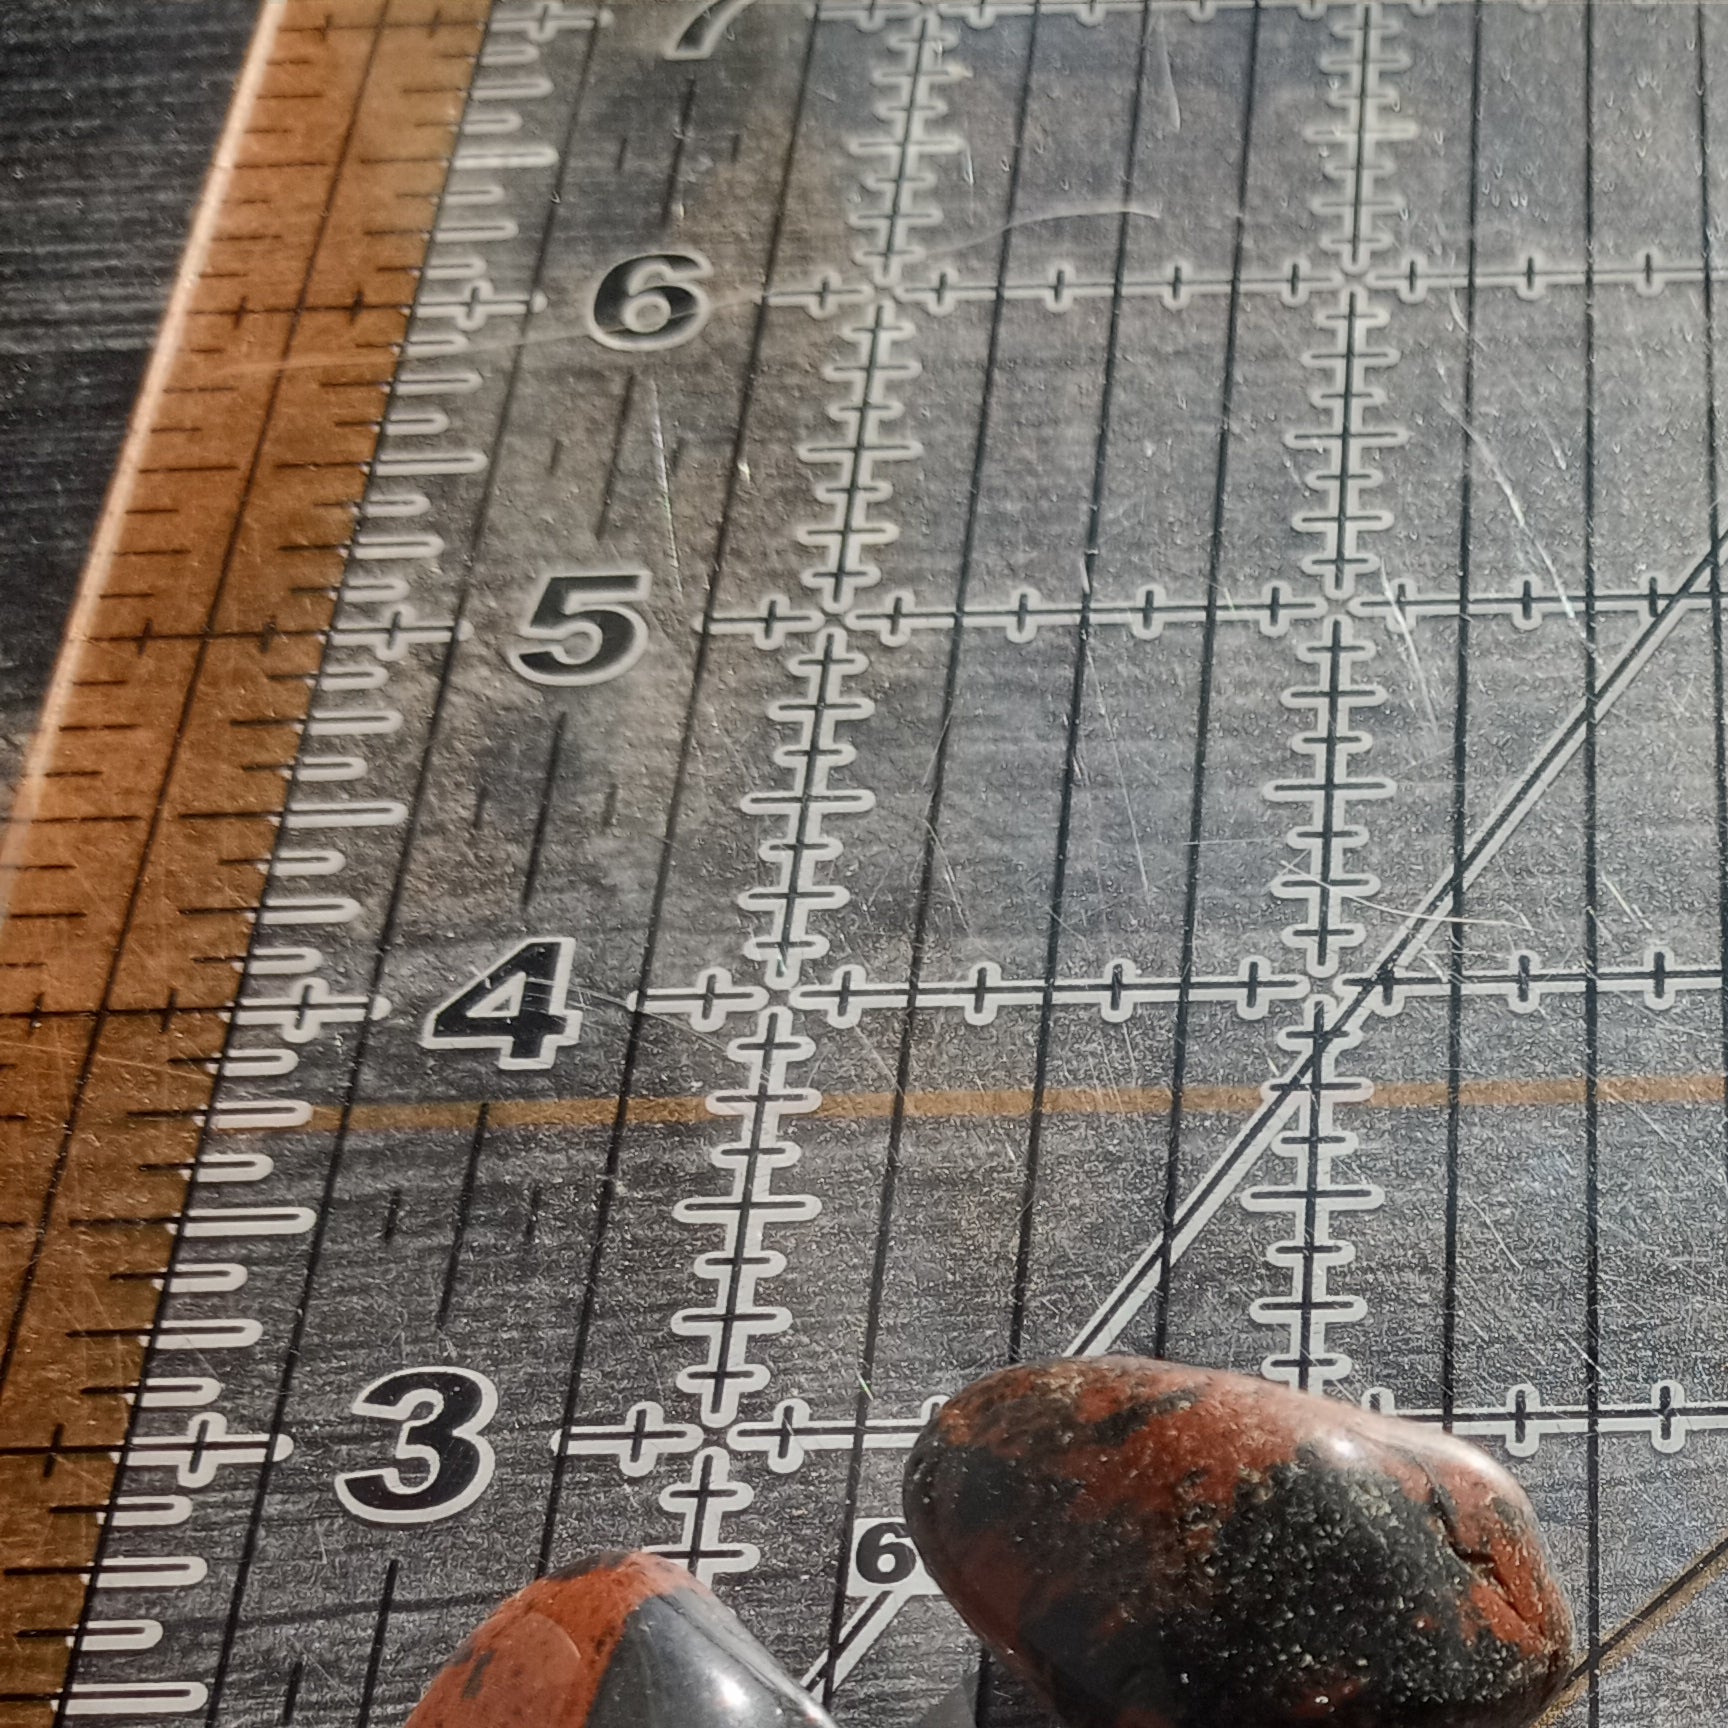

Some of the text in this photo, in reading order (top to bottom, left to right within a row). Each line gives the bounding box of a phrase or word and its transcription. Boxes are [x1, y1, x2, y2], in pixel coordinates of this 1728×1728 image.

[590, 252, 713, 350] 6
[510, 571, 651, 686] 5
[422, 937, 584, 1070] 4
[334, 1366, 498, 1524] 3
[855, 1521, 917, 1585] 6
